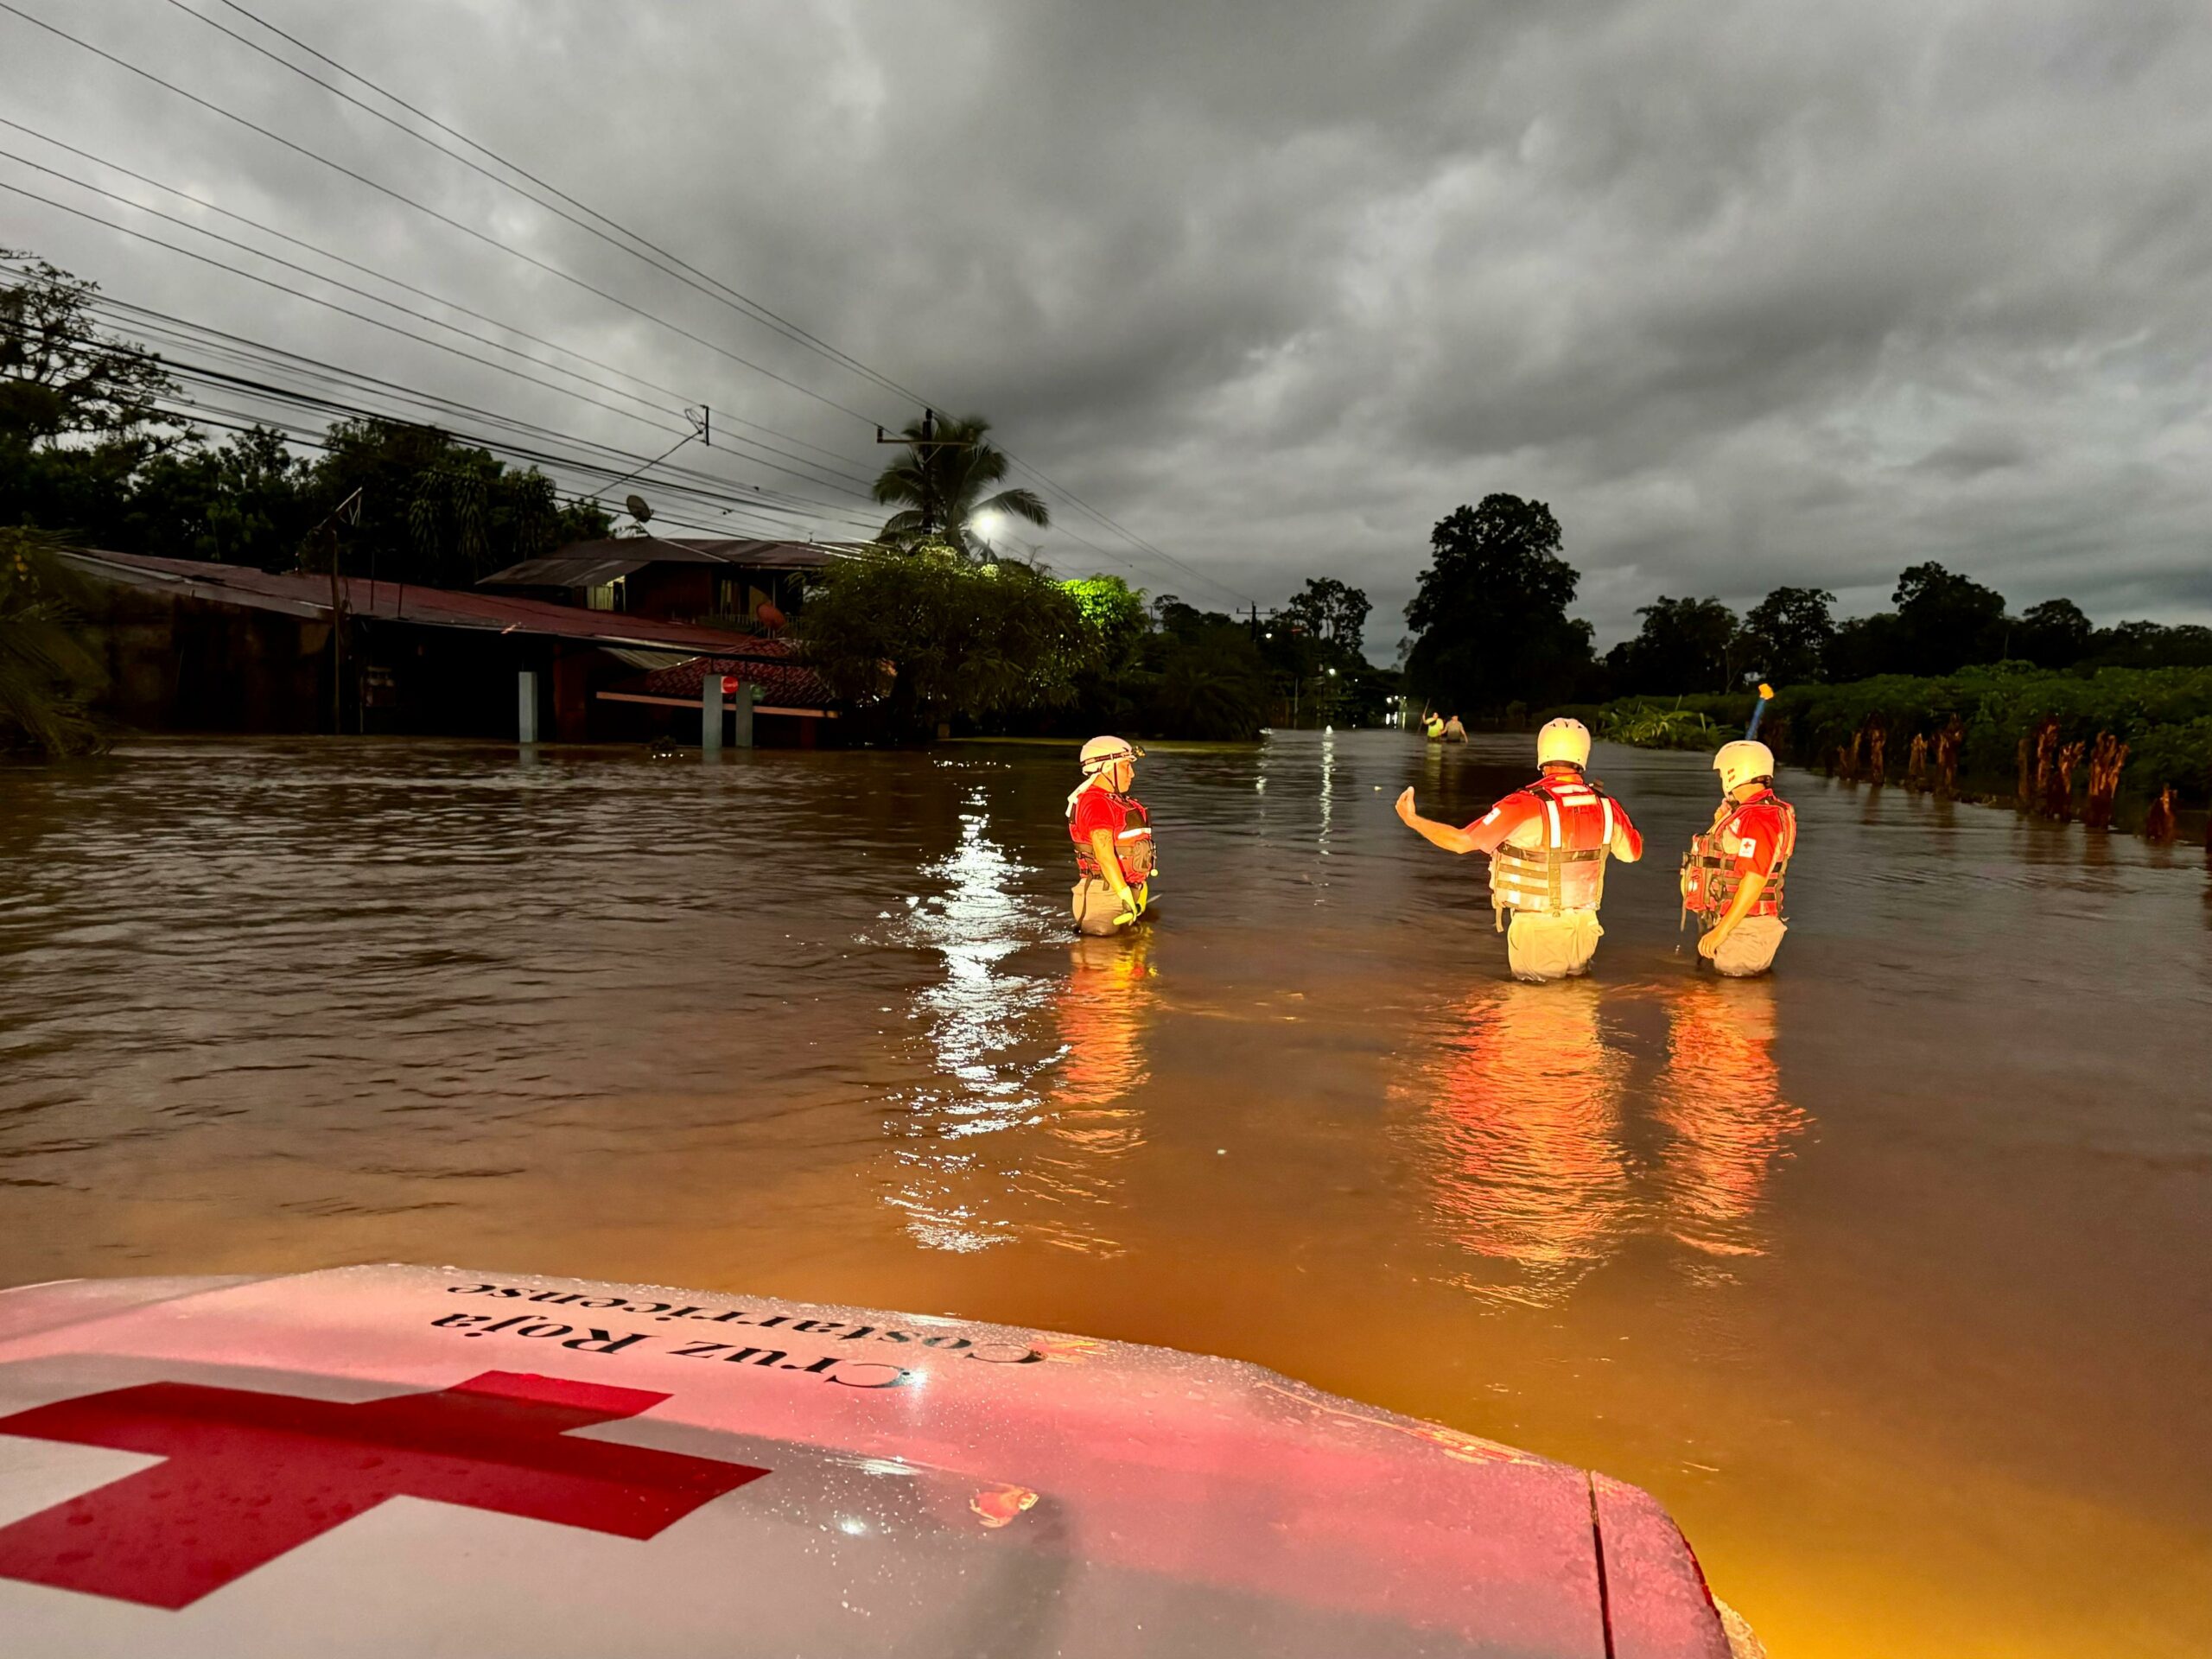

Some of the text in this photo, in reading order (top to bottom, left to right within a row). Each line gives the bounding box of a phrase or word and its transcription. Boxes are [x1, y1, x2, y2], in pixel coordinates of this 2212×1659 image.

[430, 1313, 912, 1389] Cruz Roja
[447, 1283, 1049, 1363] Costarricense
